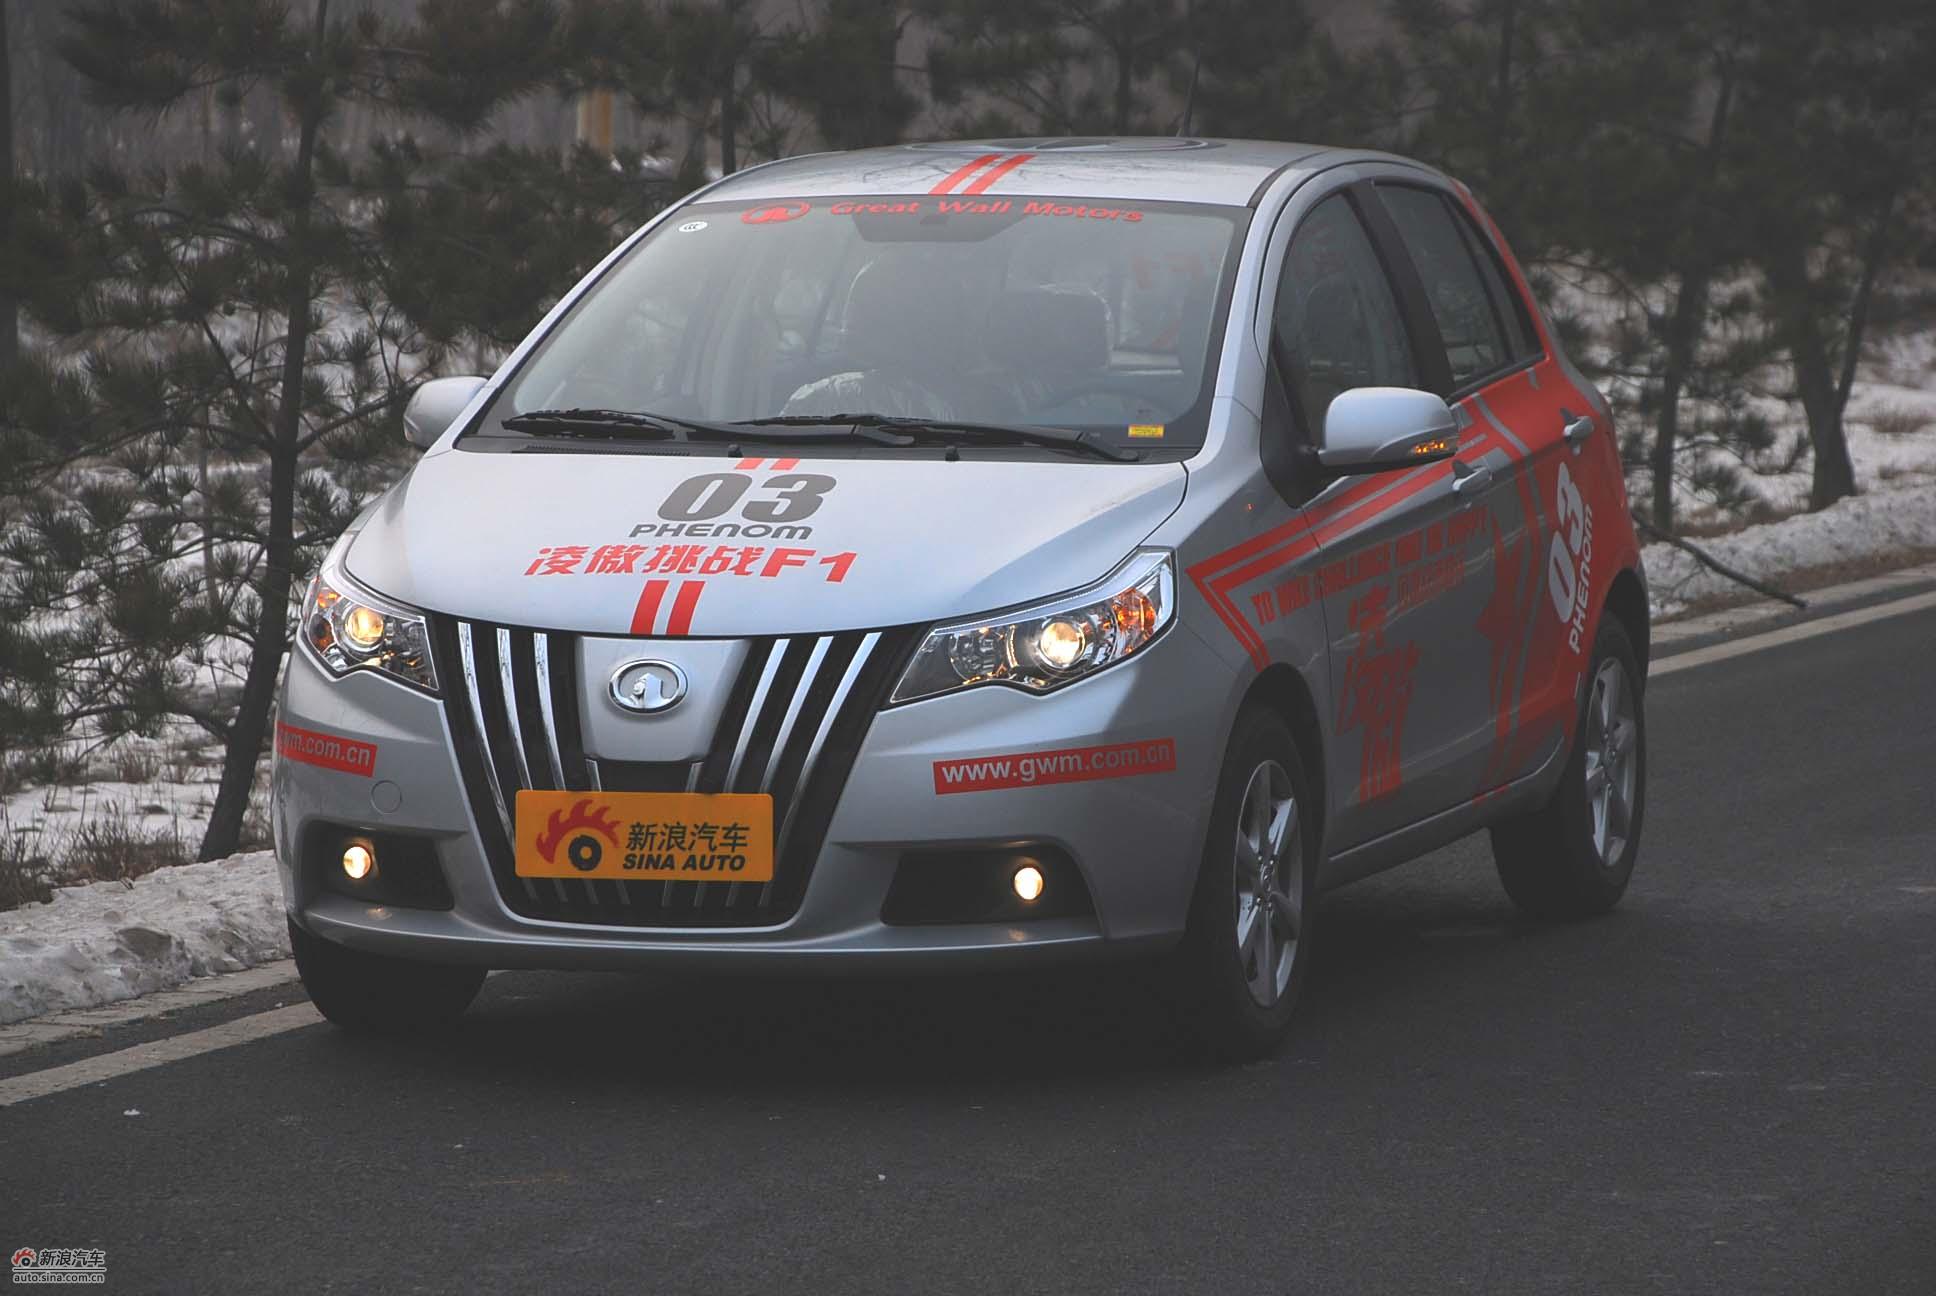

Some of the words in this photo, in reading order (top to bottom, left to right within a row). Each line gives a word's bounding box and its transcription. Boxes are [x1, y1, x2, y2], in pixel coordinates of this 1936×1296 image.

[830, 202, 920, 215] Great
[938, 201, 1012, 214] Wall
[1023, 202, 1144, 222] Motors
[657, 472, 837, 523] 03
[629, 523, 813, 540] PHENOM
[1549, 461, 1584, 624] 03
[524, 544, 857, 583] 凌傲挑战F1
[1568, 504, 1593, 655] PHENOM
[942, 744, 1170, 783] www.gwm.com.cn
[625, 822, 750, 852] 新浪汽车
[622, 853, 675, 871] SINA
[681, 854, 746, 871] AUTO
